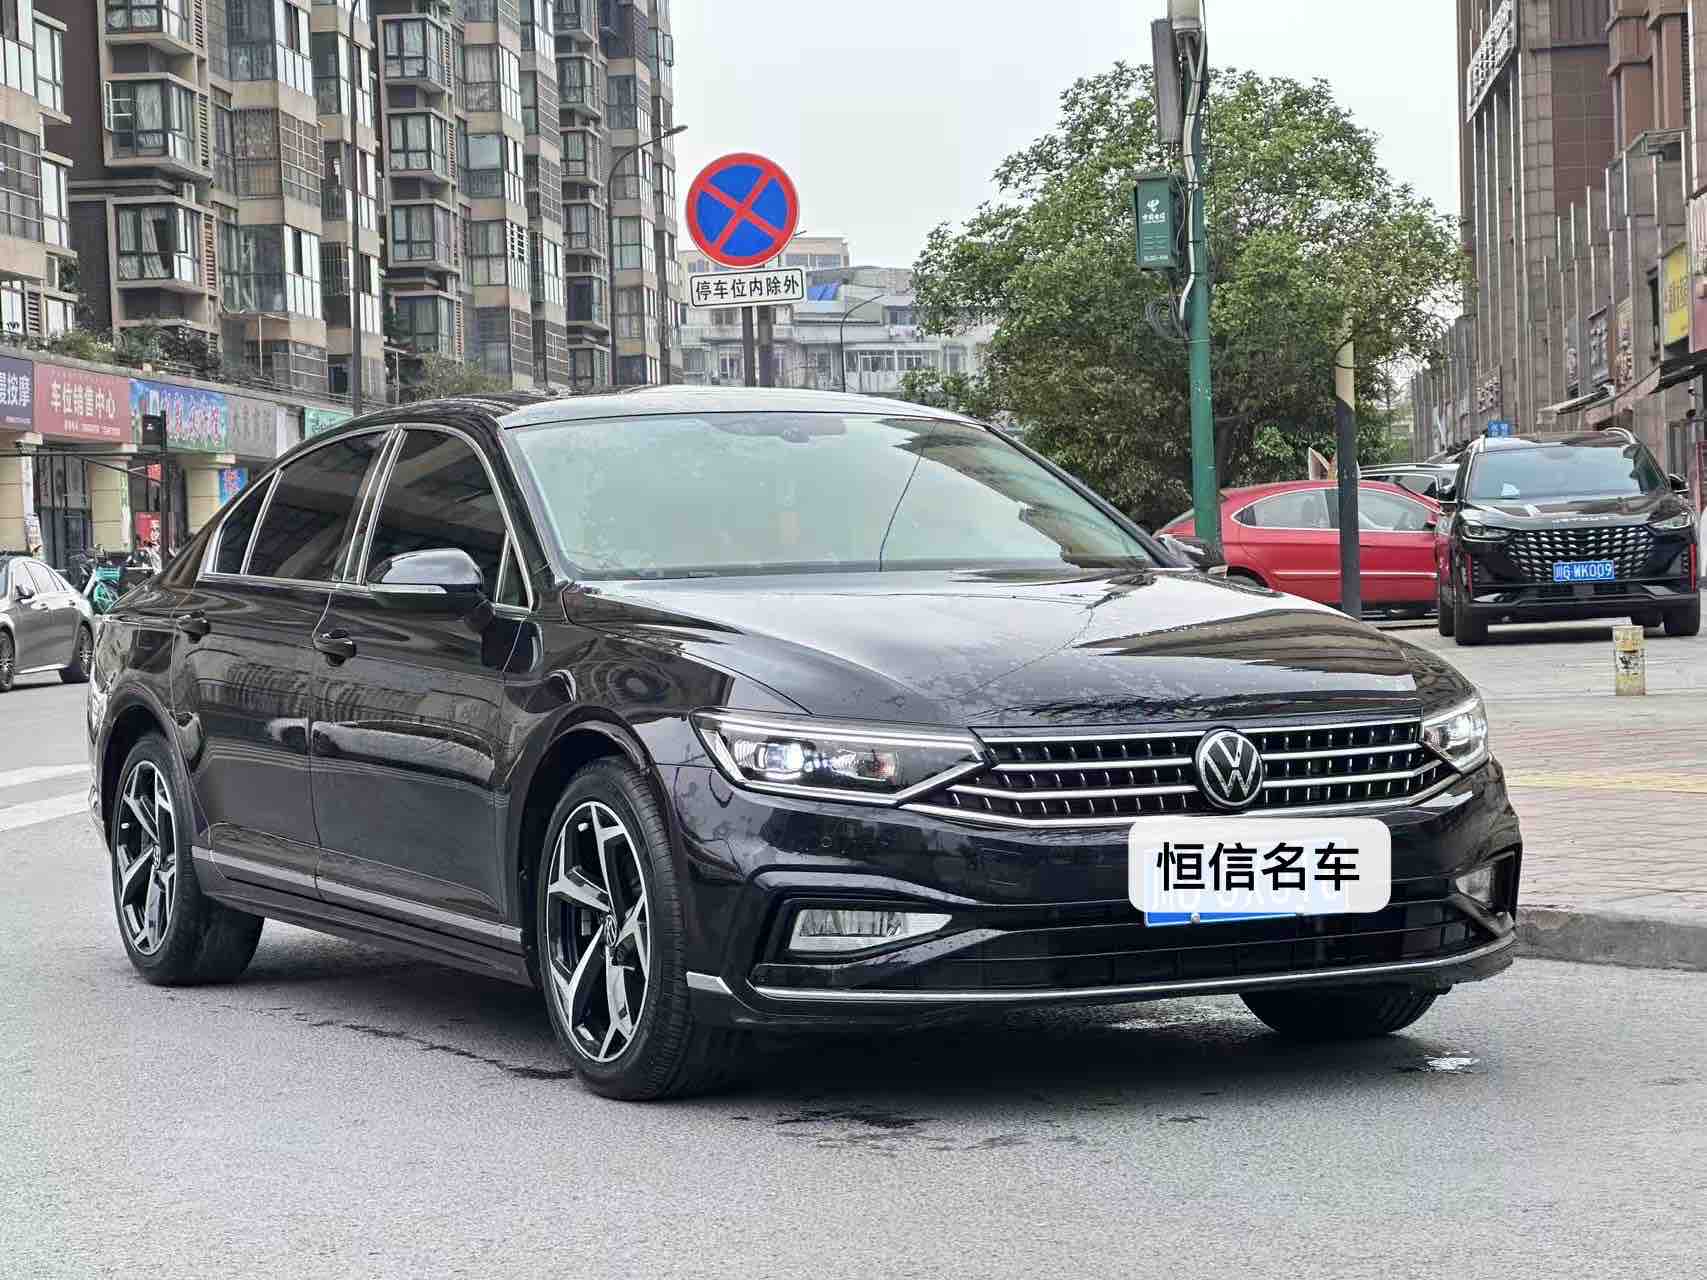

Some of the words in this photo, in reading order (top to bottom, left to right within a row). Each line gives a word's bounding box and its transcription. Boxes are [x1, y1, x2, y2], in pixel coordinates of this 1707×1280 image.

[695, 274, 800, 301] 停车位内除外
[50, 380, 116, 419] 车位销售中心
